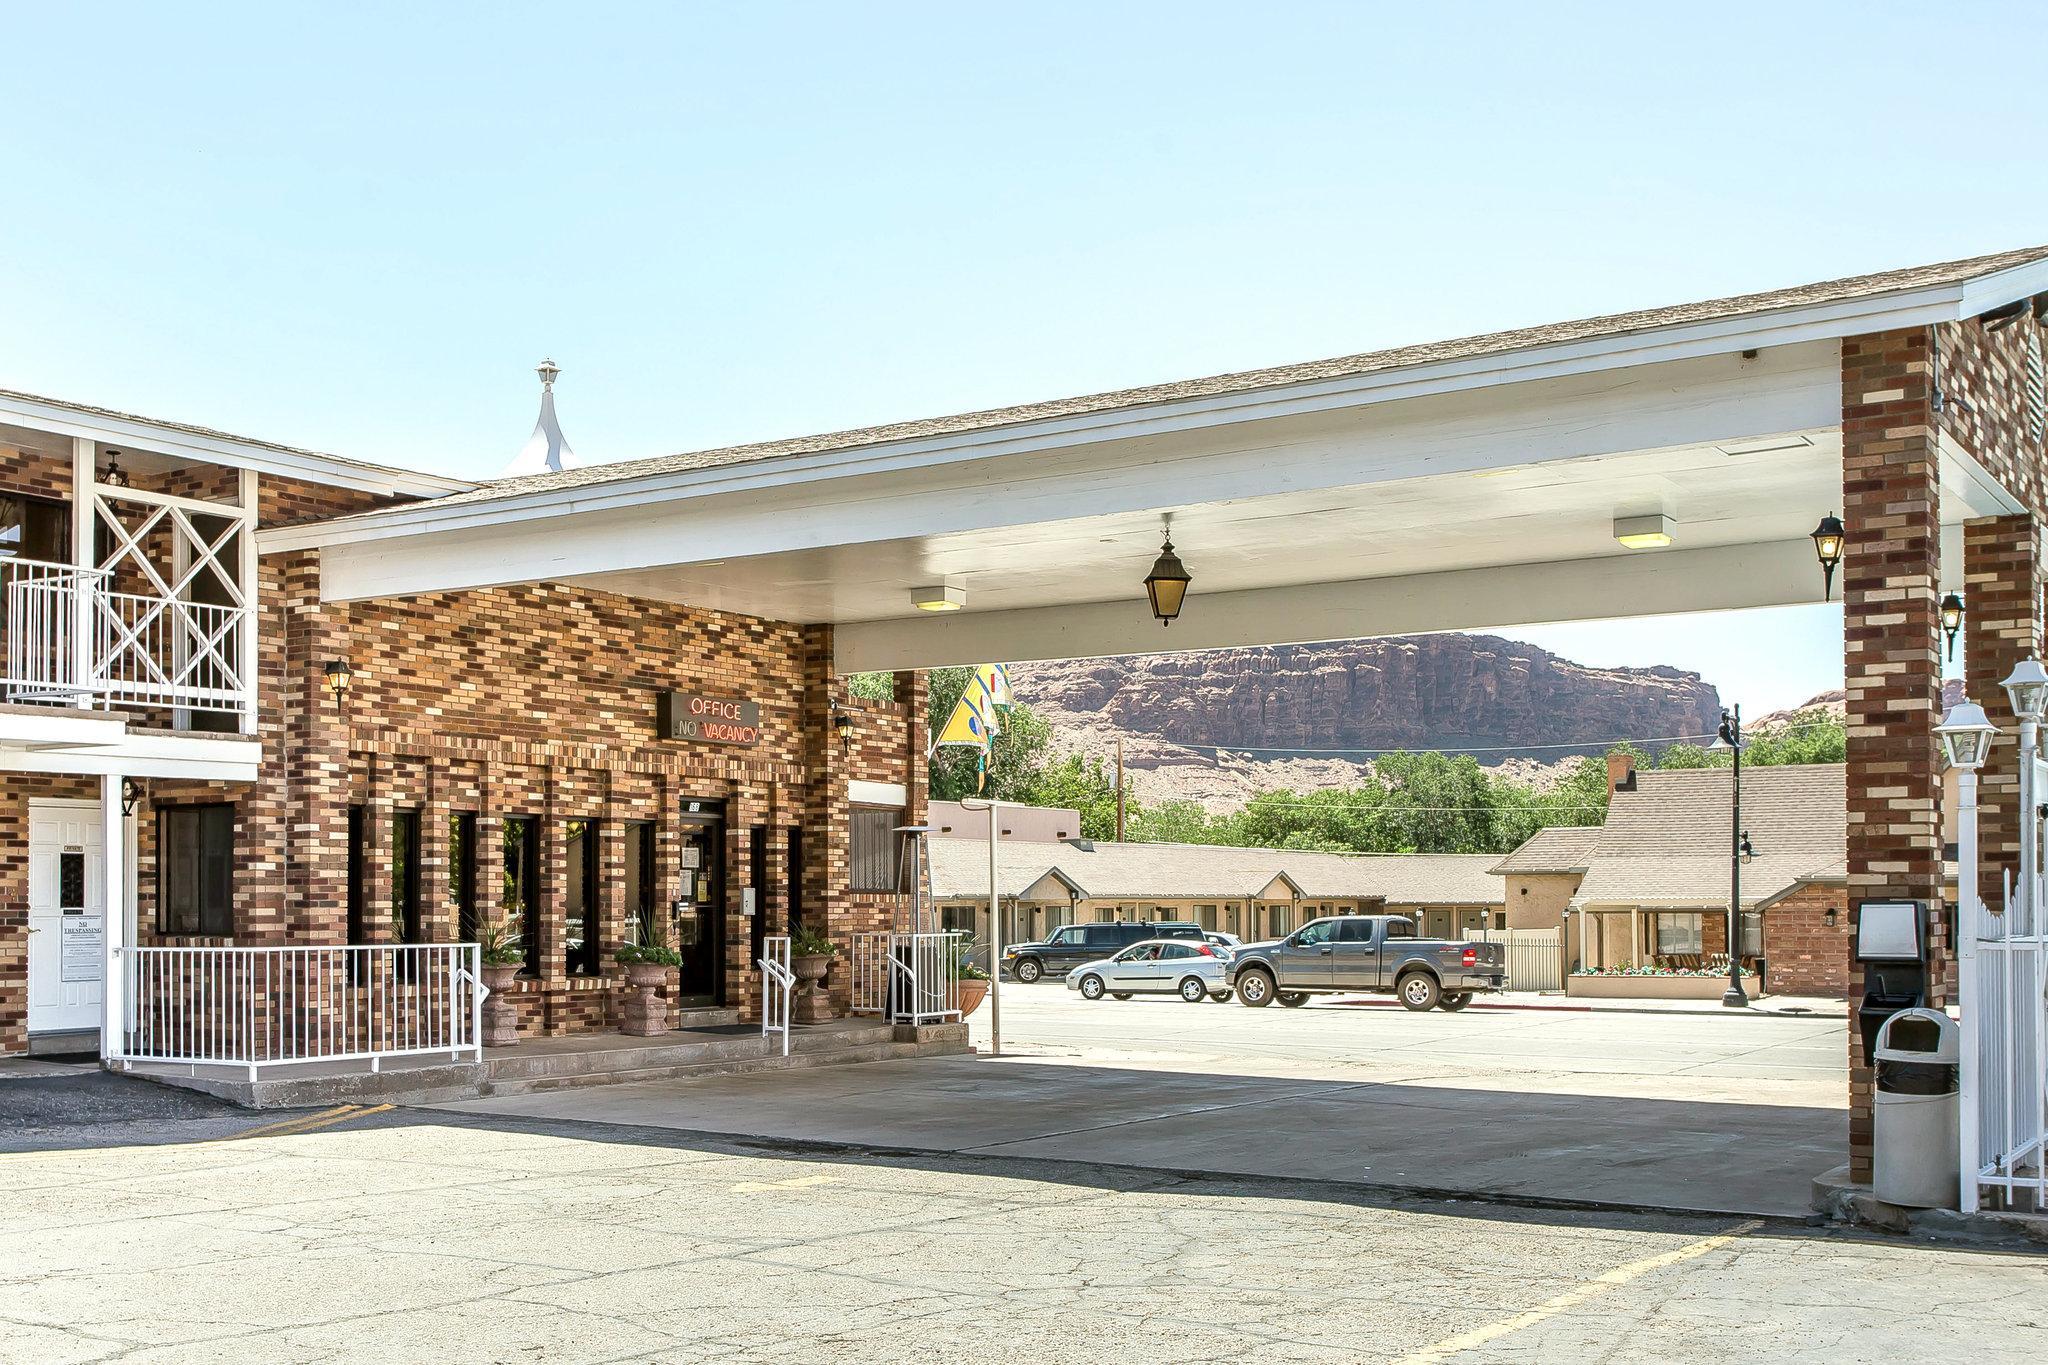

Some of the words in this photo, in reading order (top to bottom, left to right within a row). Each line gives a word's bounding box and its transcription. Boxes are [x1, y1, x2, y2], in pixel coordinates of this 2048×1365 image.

[691, 697, 742, 721] OFFICE
[679, 720, 697, 737] NO
[703, 722, 758, 743] VACANCY
[64, 927, 102, 935] TRESPASSING
